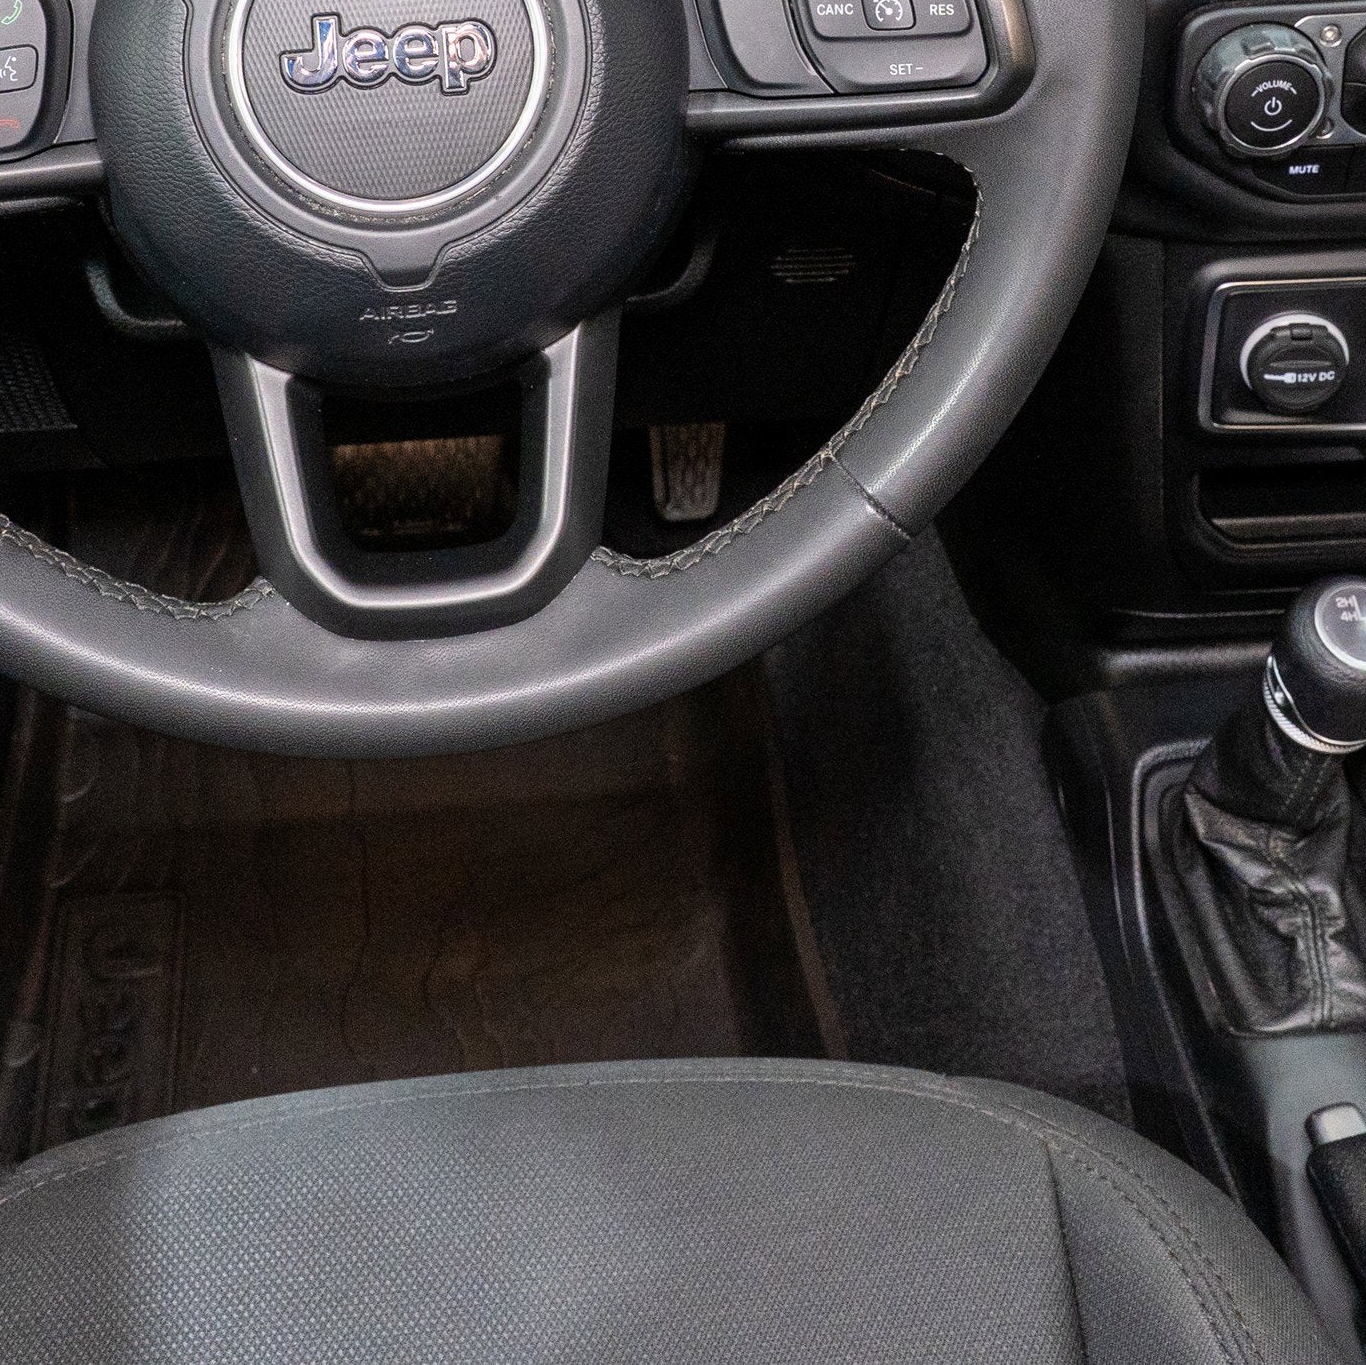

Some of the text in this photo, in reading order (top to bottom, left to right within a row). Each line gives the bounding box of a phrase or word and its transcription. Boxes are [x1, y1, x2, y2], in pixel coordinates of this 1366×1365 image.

[817, 4, 854, 15] CANC
[930, 4, 954, 16] RES
[280, 13, 497, 96] Jeep
[1256, 80, 1291, 93] VOLUME
[1289, 164, 1319, 174] MUTE
[359, 299, 458, 320] AIRBAG
[1297, 369, 1336, 384] 12V DC
[1335, 596, 1353, 608] 2H
